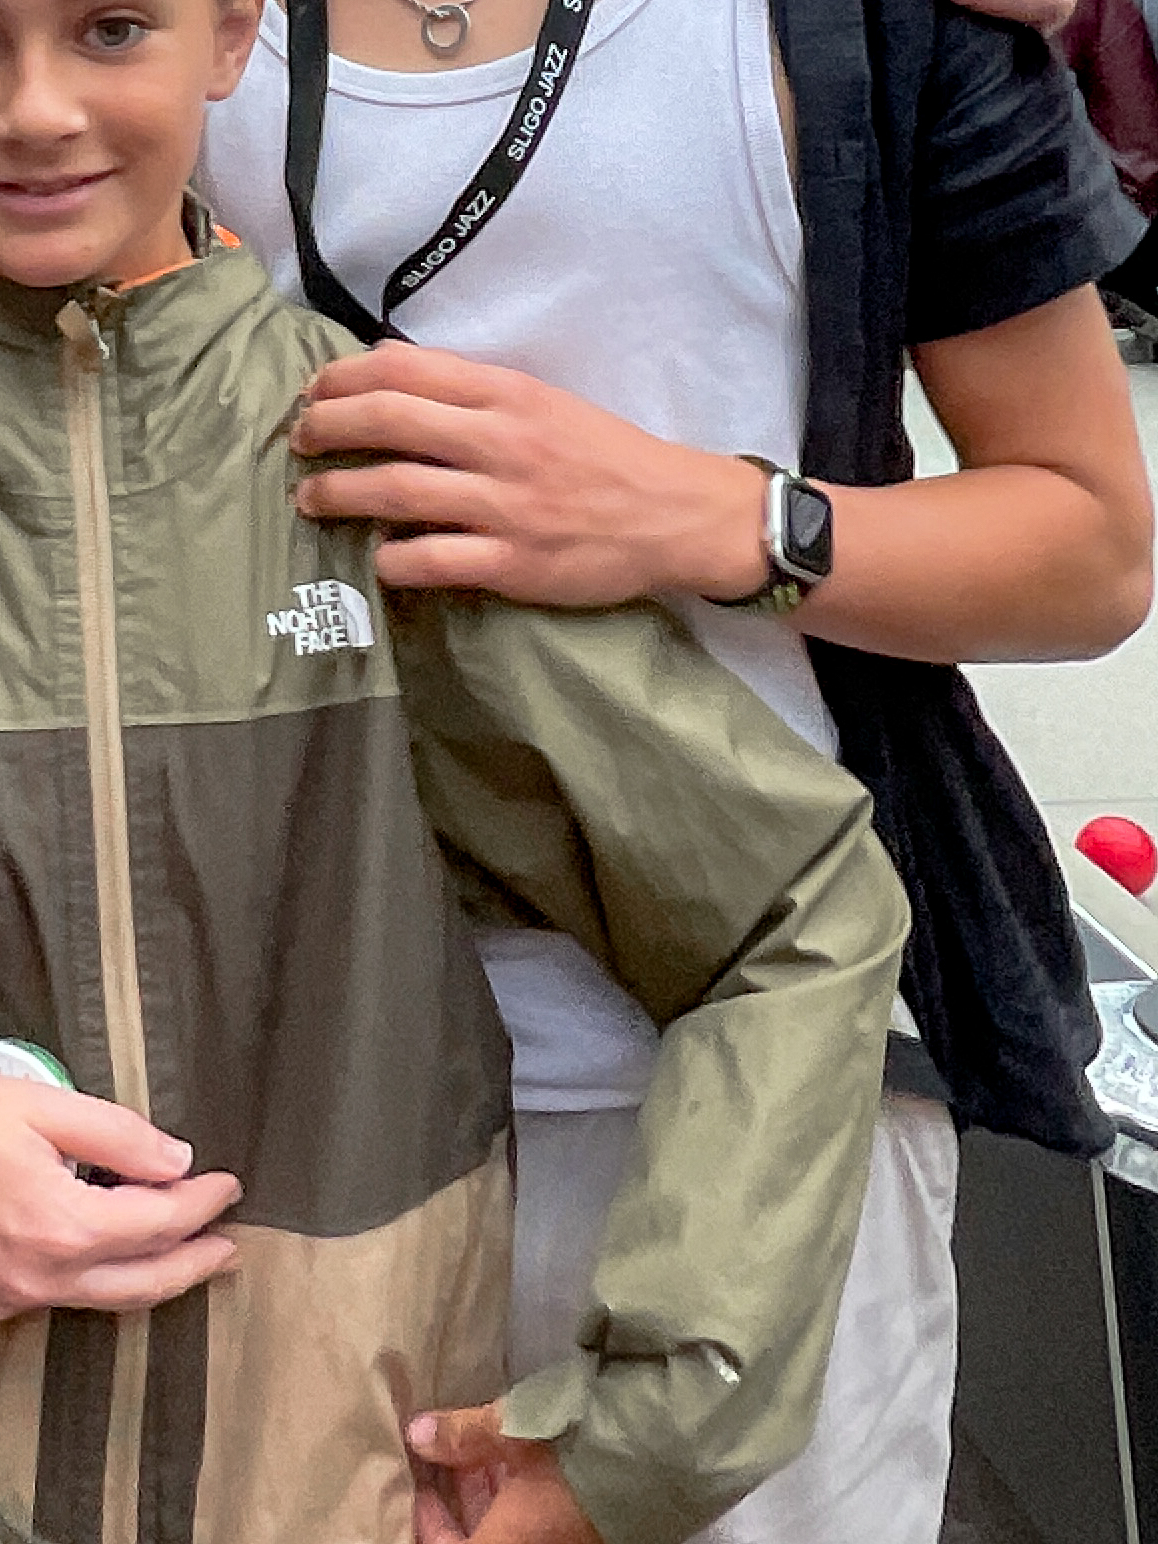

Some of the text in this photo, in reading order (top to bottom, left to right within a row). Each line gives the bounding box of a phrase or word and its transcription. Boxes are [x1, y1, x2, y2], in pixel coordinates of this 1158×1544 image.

[507, 41, 570, 162] SLIGO JAZZ
[401, 189, 497, 288] SLIGO JAZZ
[292, 580, 341, 609] THE
[266, 604, 343, 636] NORTH
[294, 626, 350, 656] FACE
